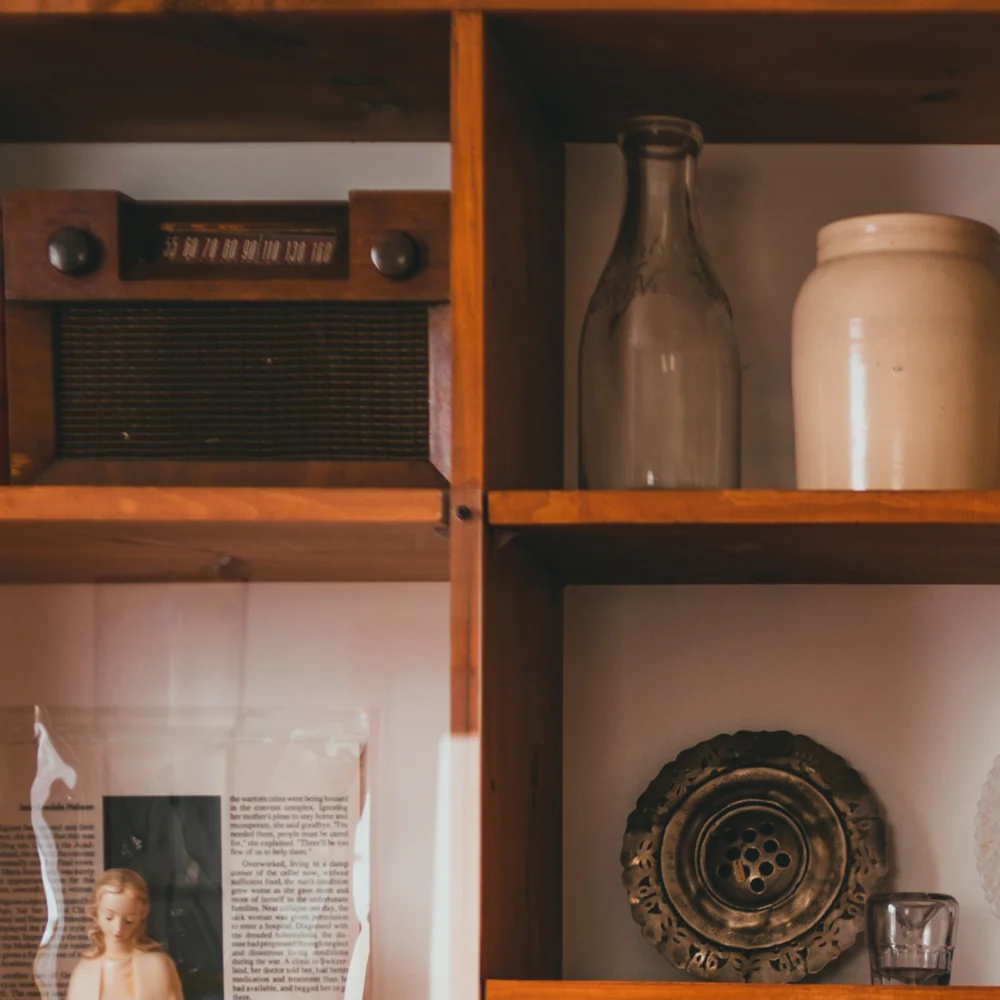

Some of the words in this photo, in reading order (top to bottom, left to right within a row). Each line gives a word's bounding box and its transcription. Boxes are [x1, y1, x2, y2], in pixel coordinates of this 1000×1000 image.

[182, 237, 199, 259] 60
[202, 237, 219, 259] 70
[222, 238, 239, 260] 80
[241, 239, 258, 260] 90
[262, 240, 280, 261] 110
[285, 240, 307, 262] 130
[311, 241, 333, 263] 160
